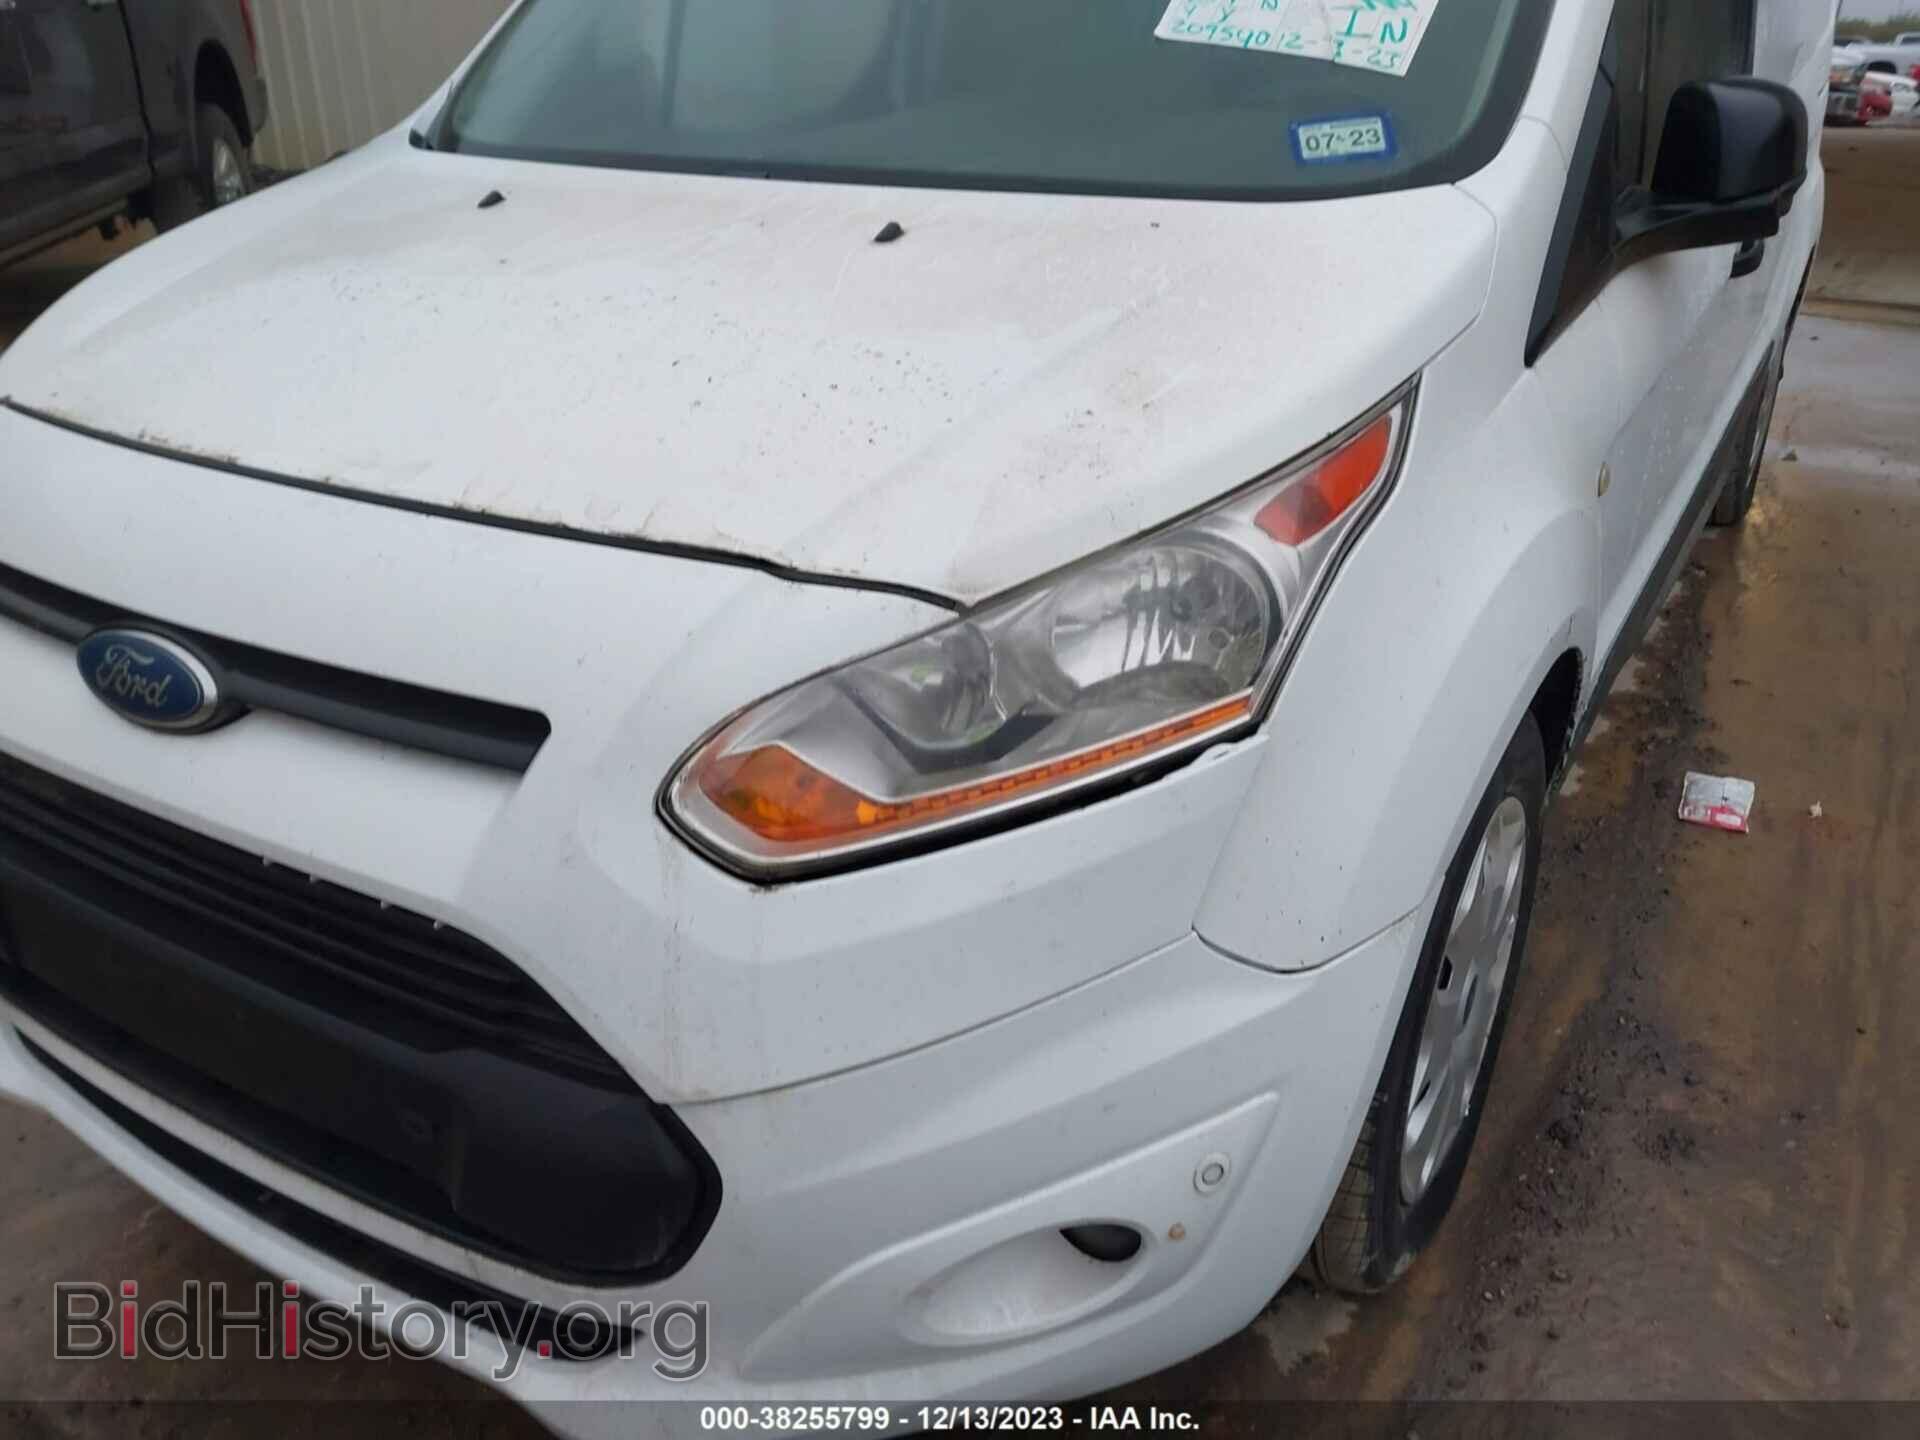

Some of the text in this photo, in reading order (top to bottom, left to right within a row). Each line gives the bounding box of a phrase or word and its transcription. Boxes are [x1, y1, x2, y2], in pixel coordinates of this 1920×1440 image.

[1305, 128, 1380, 151] 07 23
[96, 643, 172, 707] Ford
